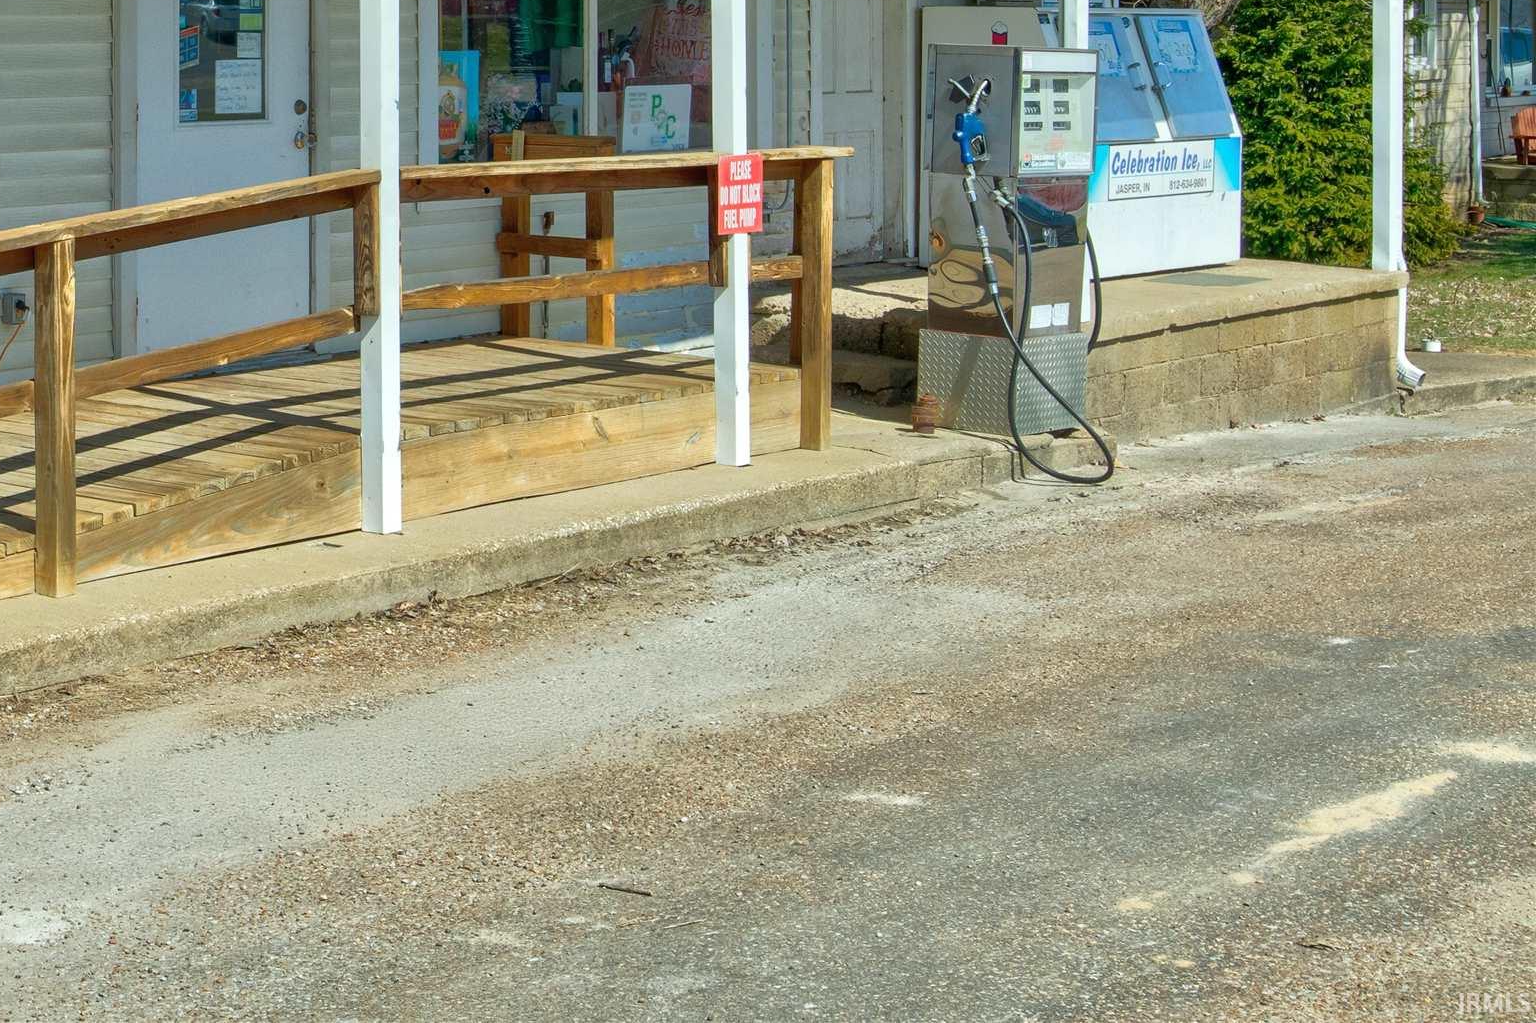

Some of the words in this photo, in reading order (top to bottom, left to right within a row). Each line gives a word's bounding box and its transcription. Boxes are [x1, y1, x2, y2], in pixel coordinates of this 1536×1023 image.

[730, 160, 752, 181] PLEASE
[1112, 149, 1178, 175] Celebration
[1181, 147, 1200, 171] Ice,
[720, 186, 729, 205] DO
[729, 185, 742, 205] NOT
[742, 183, 761, 203] BLOCK
[1115, 183, 1142, 194] JASPER,
[1143, 182, 1151, 192] IN
[724, 209, 738, 229] FUEL
[739, 208, 756, 228] PUMP
